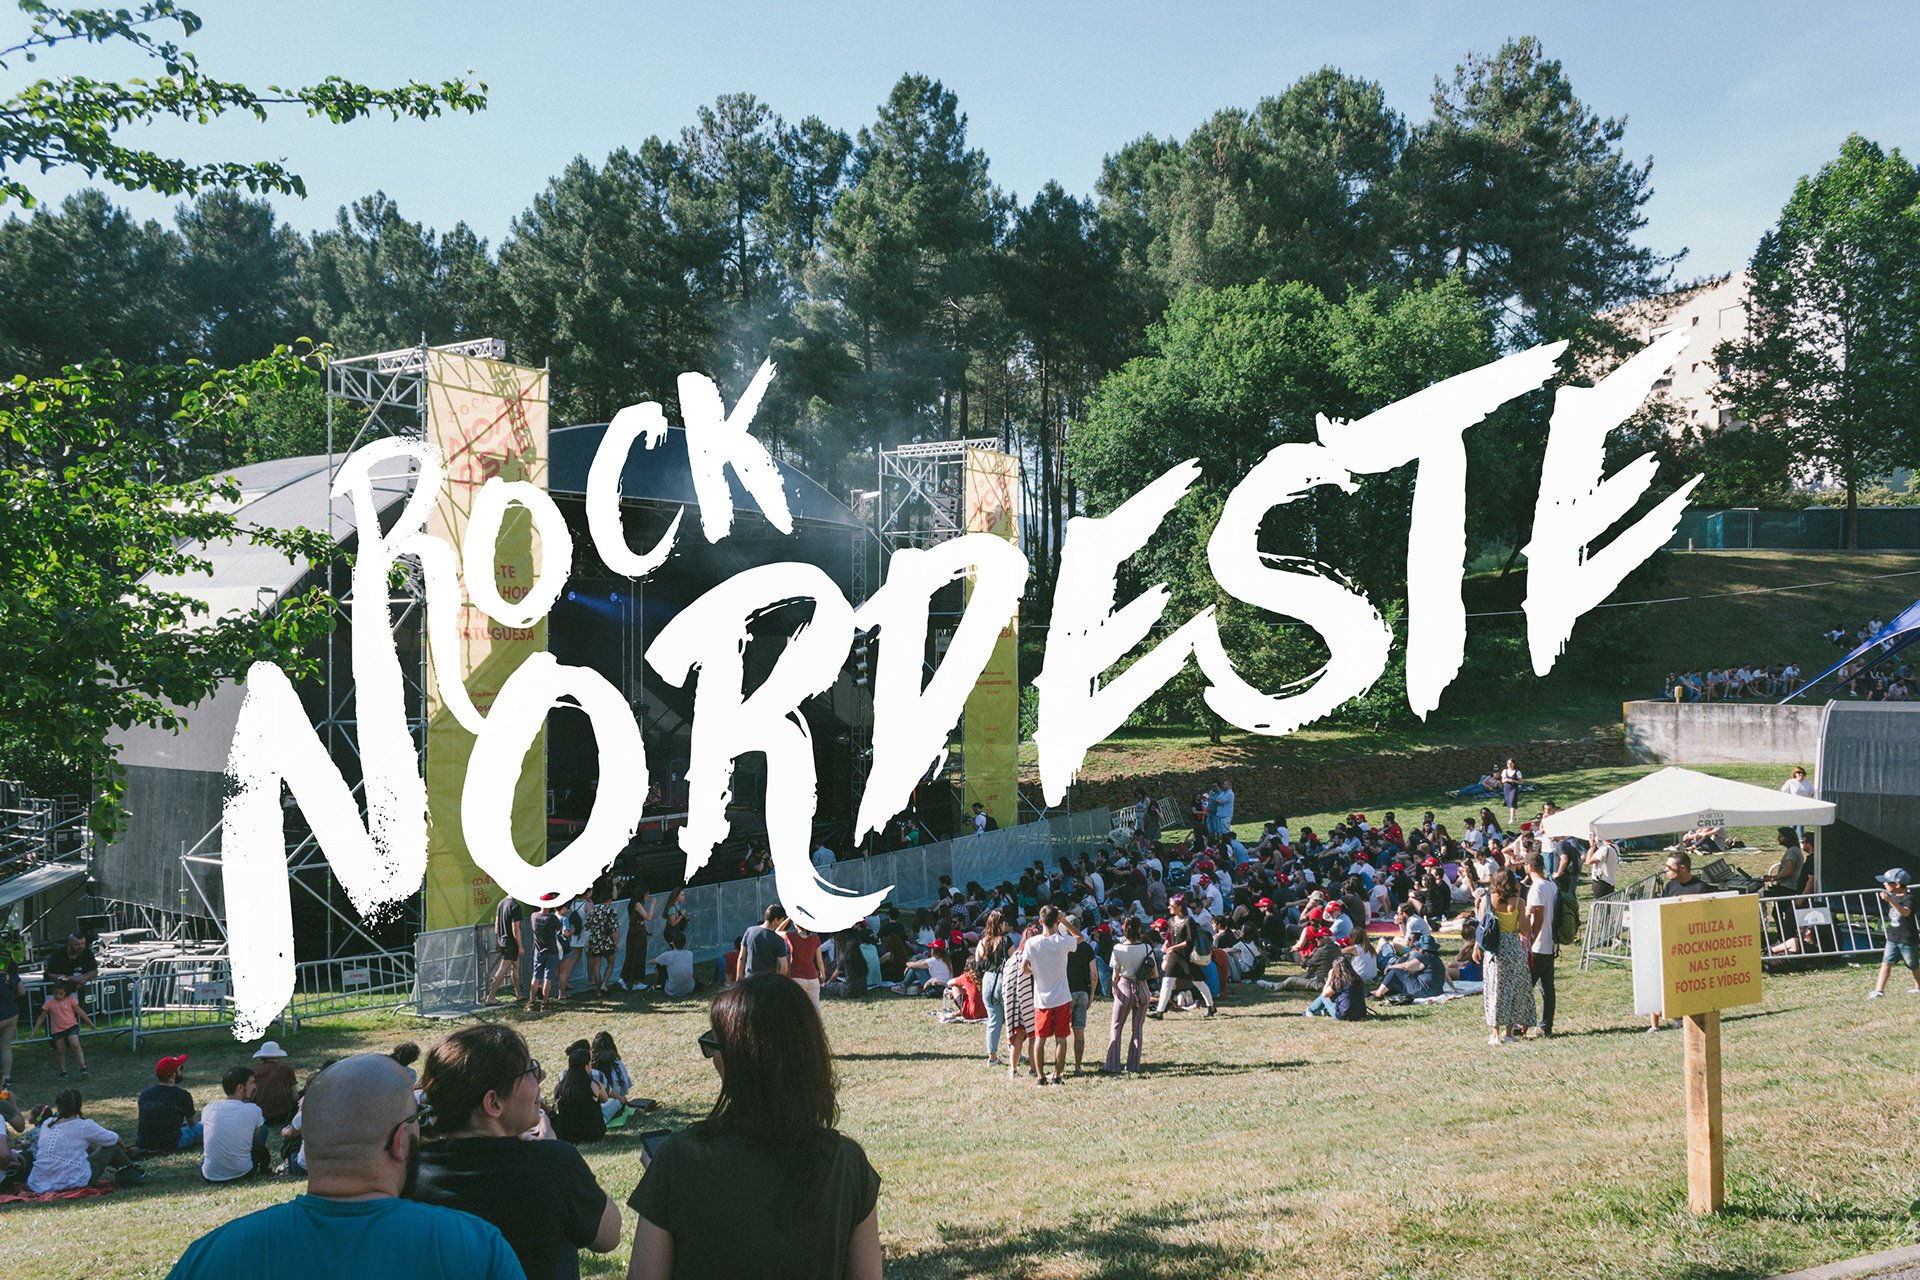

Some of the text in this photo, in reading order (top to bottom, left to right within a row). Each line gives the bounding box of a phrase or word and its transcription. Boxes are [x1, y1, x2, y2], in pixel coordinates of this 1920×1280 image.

[1697, 819, 1725, 827] CRUZ
[1698, 812, 1723, 820] PORTO
[1688, 918, 1735, 935] UTILIZA A
[1671, 934, 1752, 957] #ROCKNORDESTE
[1689, 955, 1736, 973] NAS TUAS
[1675, 970, 1751, 994] FOTOS E VÍDEOS
